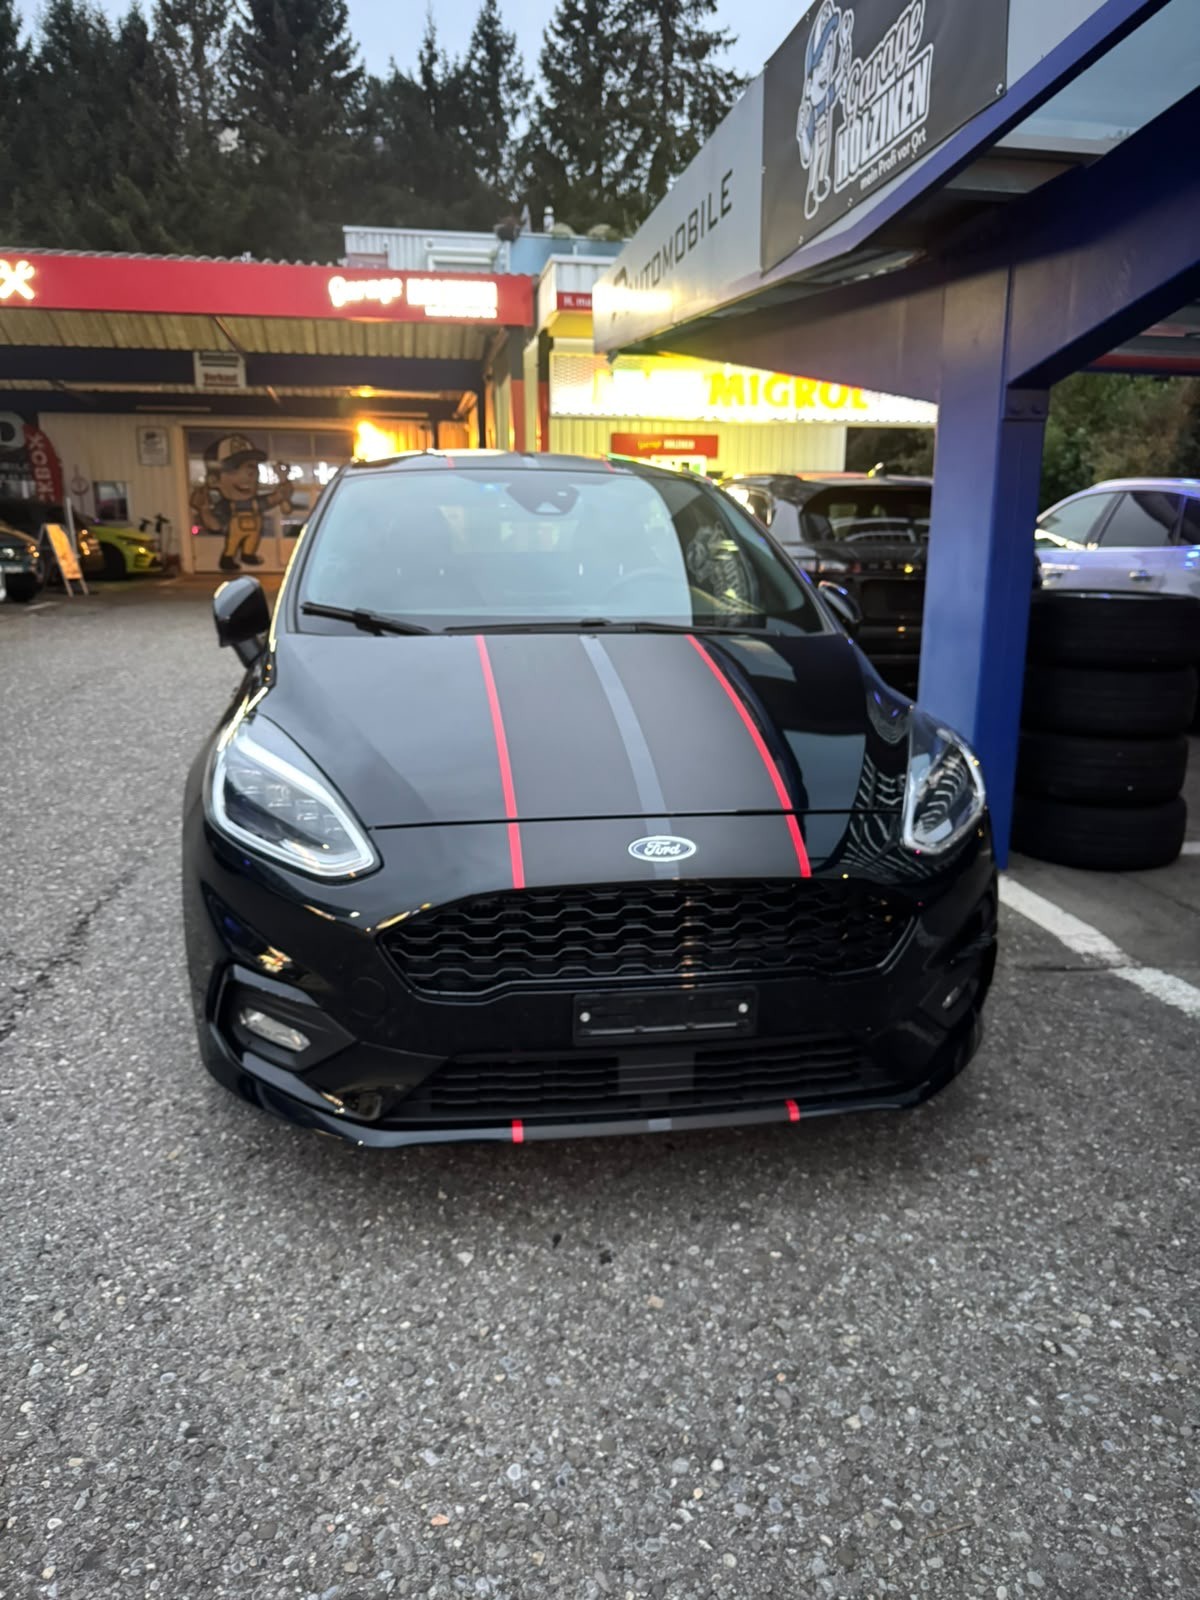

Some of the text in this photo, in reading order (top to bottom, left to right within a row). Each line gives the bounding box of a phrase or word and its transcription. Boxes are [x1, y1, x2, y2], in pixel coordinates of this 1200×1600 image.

[846, 2, 922, 116] Garage
[837, 54, 931, 184] HOLZIKEN
[860, 127, 927, 191] mein Profi vor Ort
[707, 372, 869, 410] MIGROL
[644, 840, 681, 856] Ford
